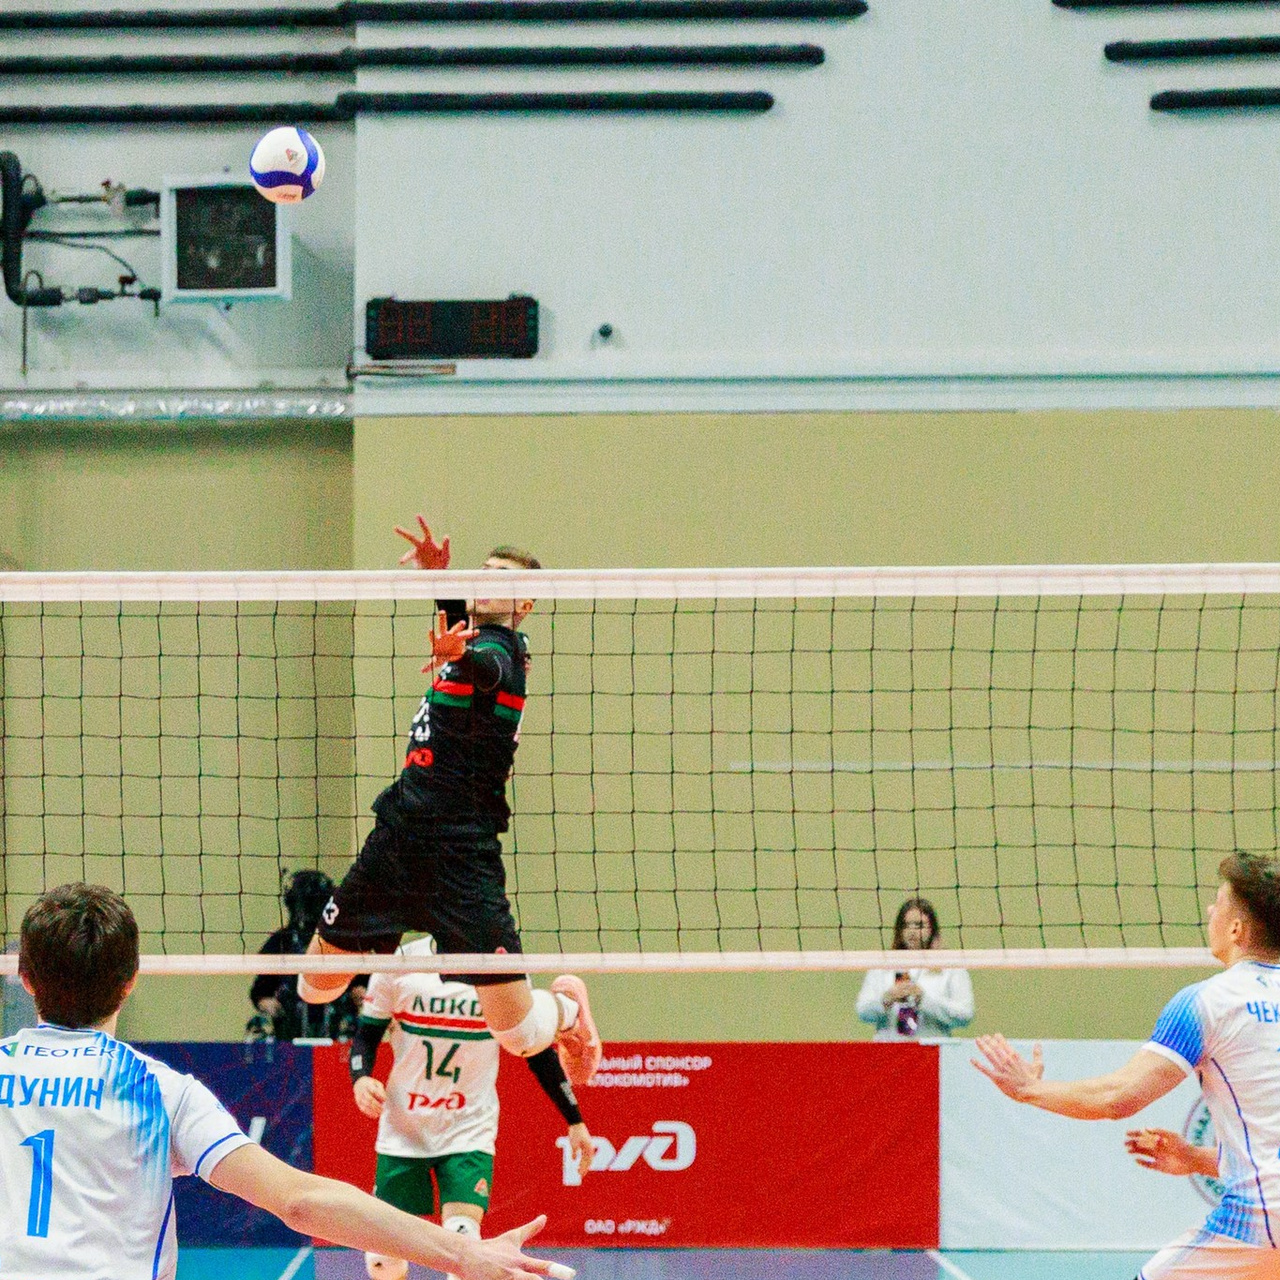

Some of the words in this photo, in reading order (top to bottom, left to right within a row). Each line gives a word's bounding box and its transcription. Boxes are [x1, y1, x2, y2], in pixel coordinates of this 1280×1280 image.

[23, 1044, 117, 1059] ГЕОТЕК
[422, 1040, 461, 1084] 14
[19, 1129, 55, 1239] 1
